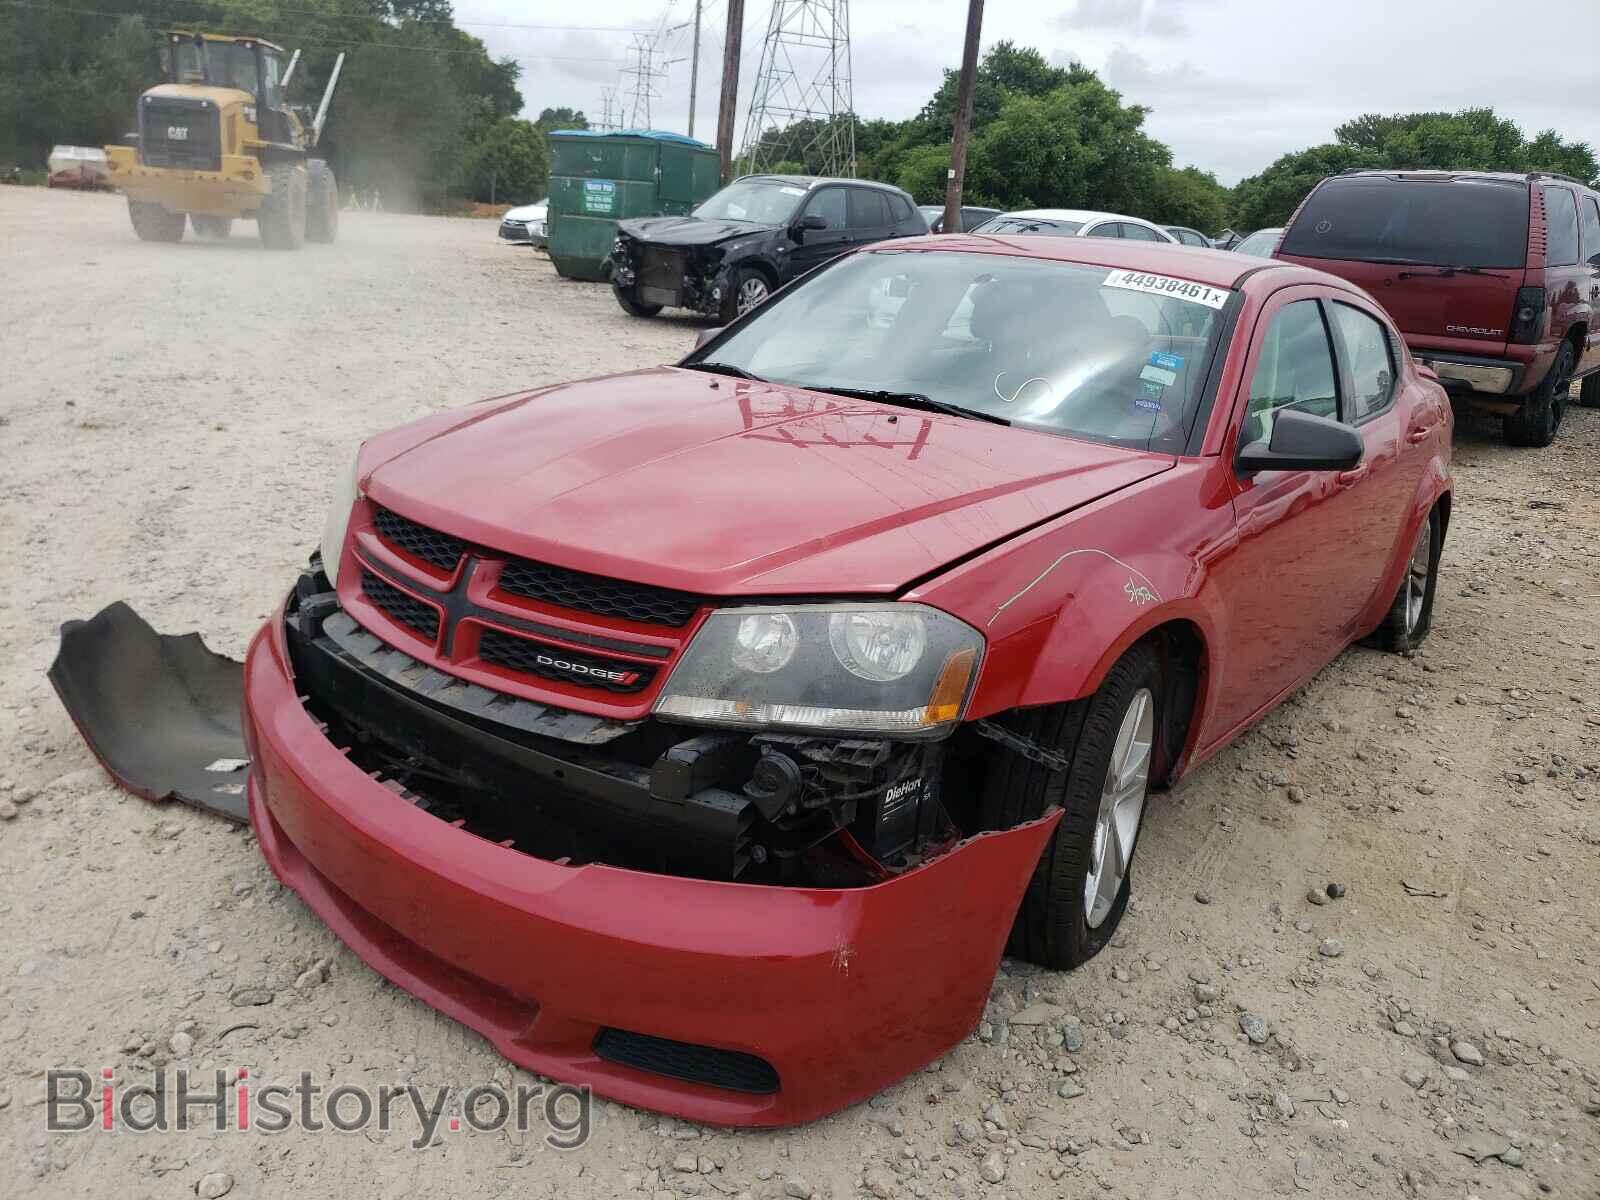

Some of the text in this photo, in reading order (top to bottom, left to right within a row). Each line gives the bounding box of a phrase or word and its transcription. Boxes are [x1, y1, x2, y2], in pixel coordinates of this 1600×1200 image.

[167, 126, 188, 140] CAT
[1446, 325, 1504, 335] CHEVROLET
[537, 655, 625, 681] DODGE
